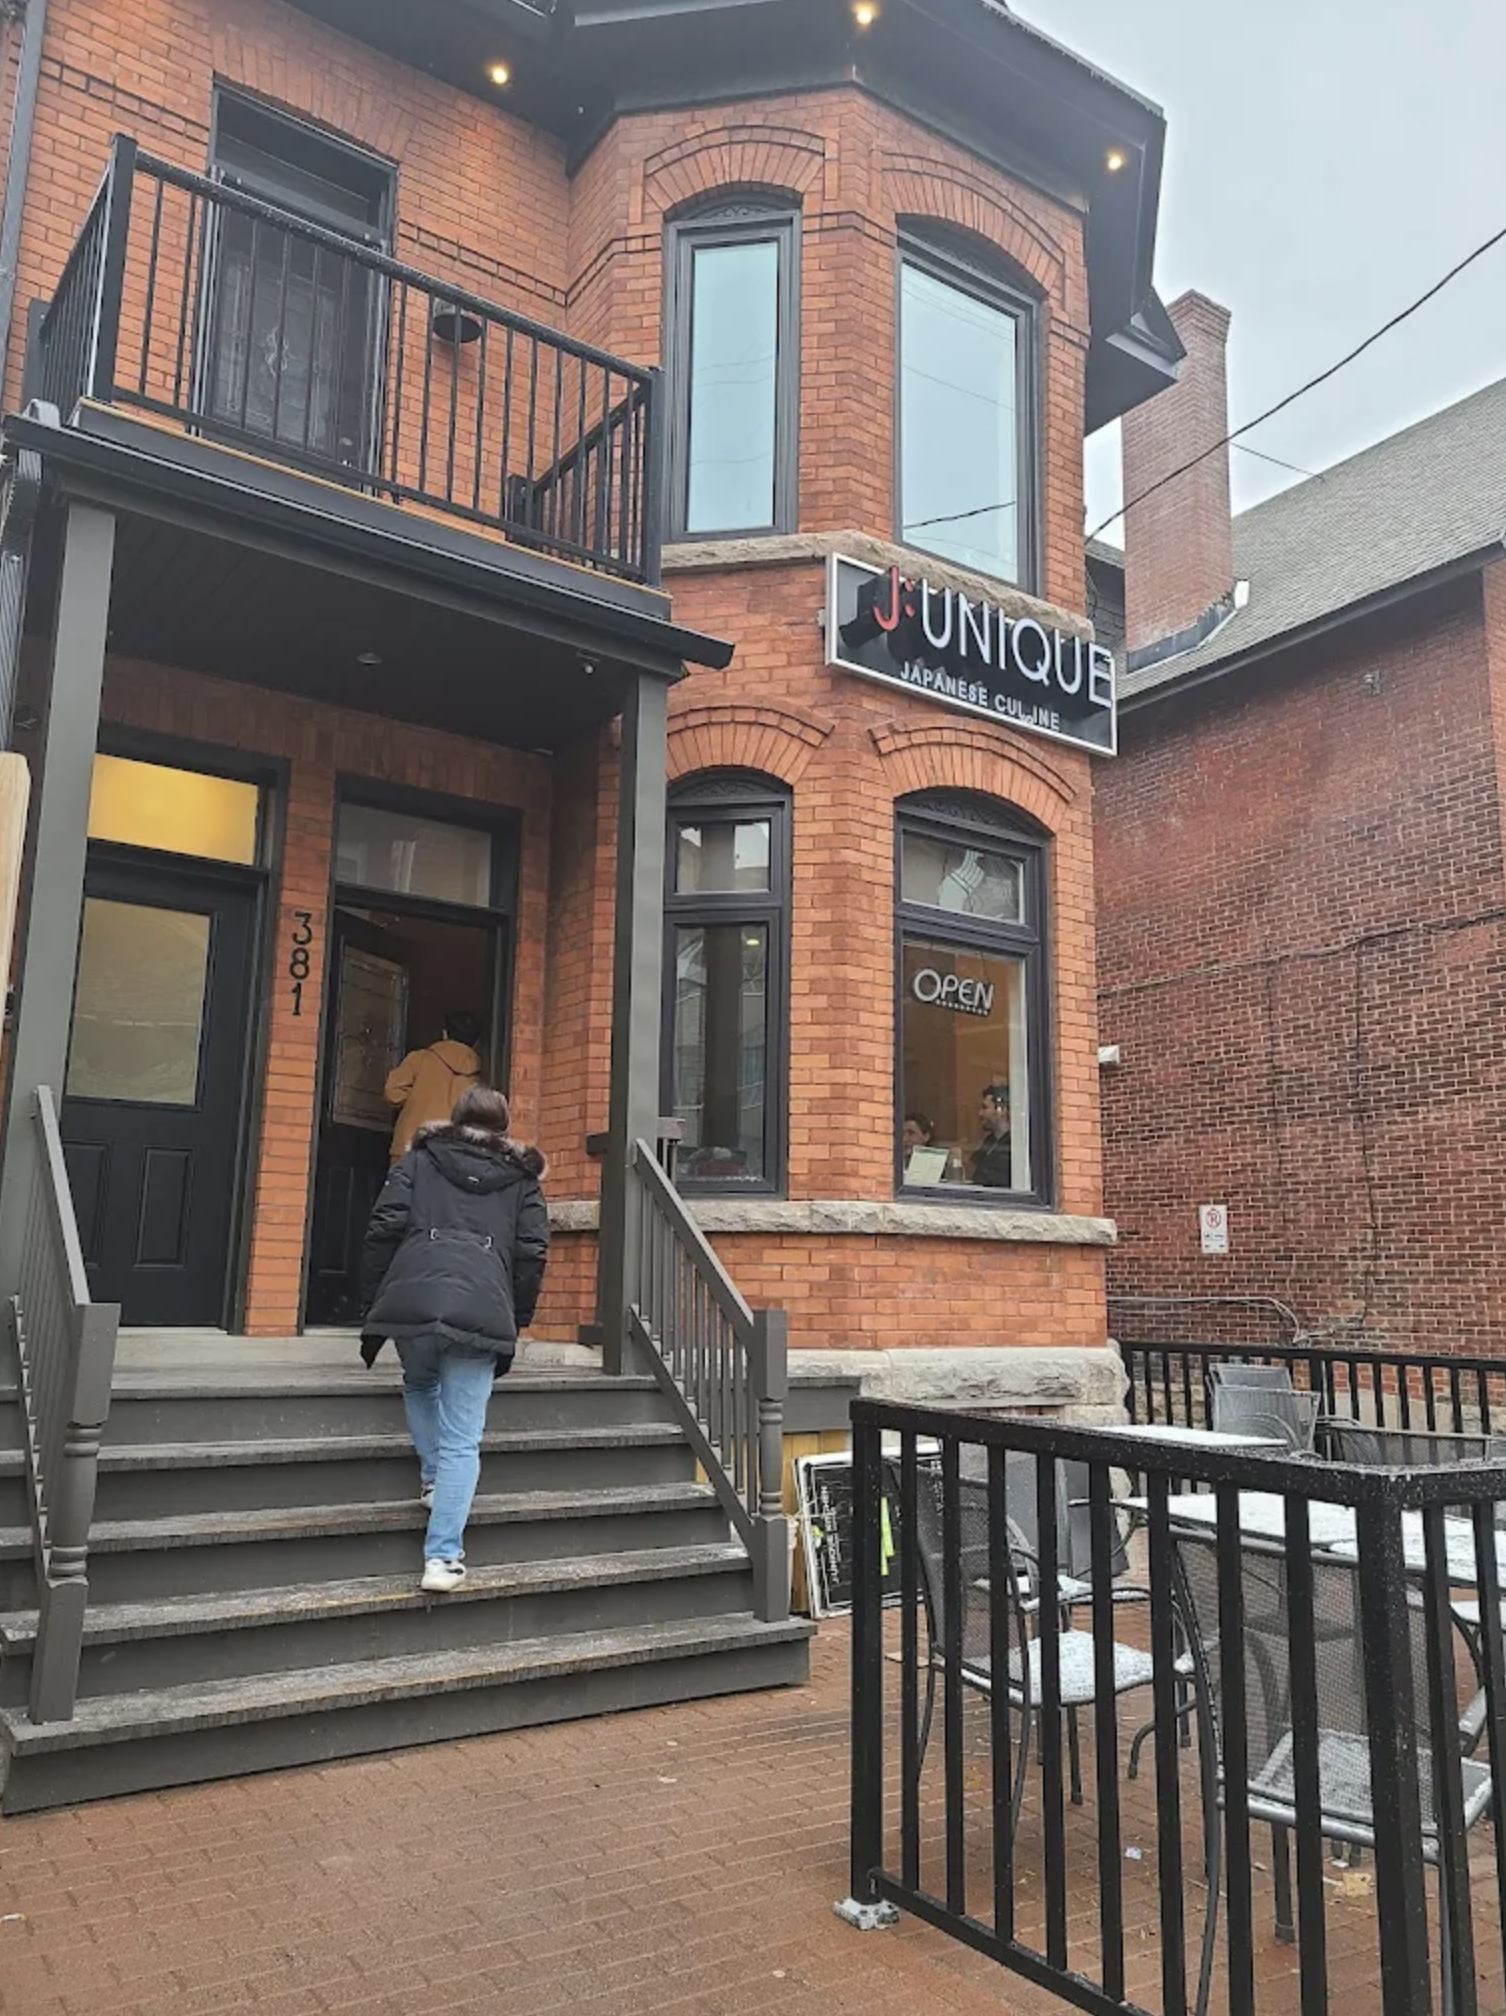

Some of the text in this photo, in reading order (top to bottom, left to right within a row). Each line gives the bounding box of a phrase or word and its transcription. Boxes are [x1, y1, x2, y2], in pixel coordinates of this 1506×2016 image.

[900, 661, 988, 707] JAPANESE
[289, 911, 312, 1016] 381
[914, 968, 994, 1010] OPEN
